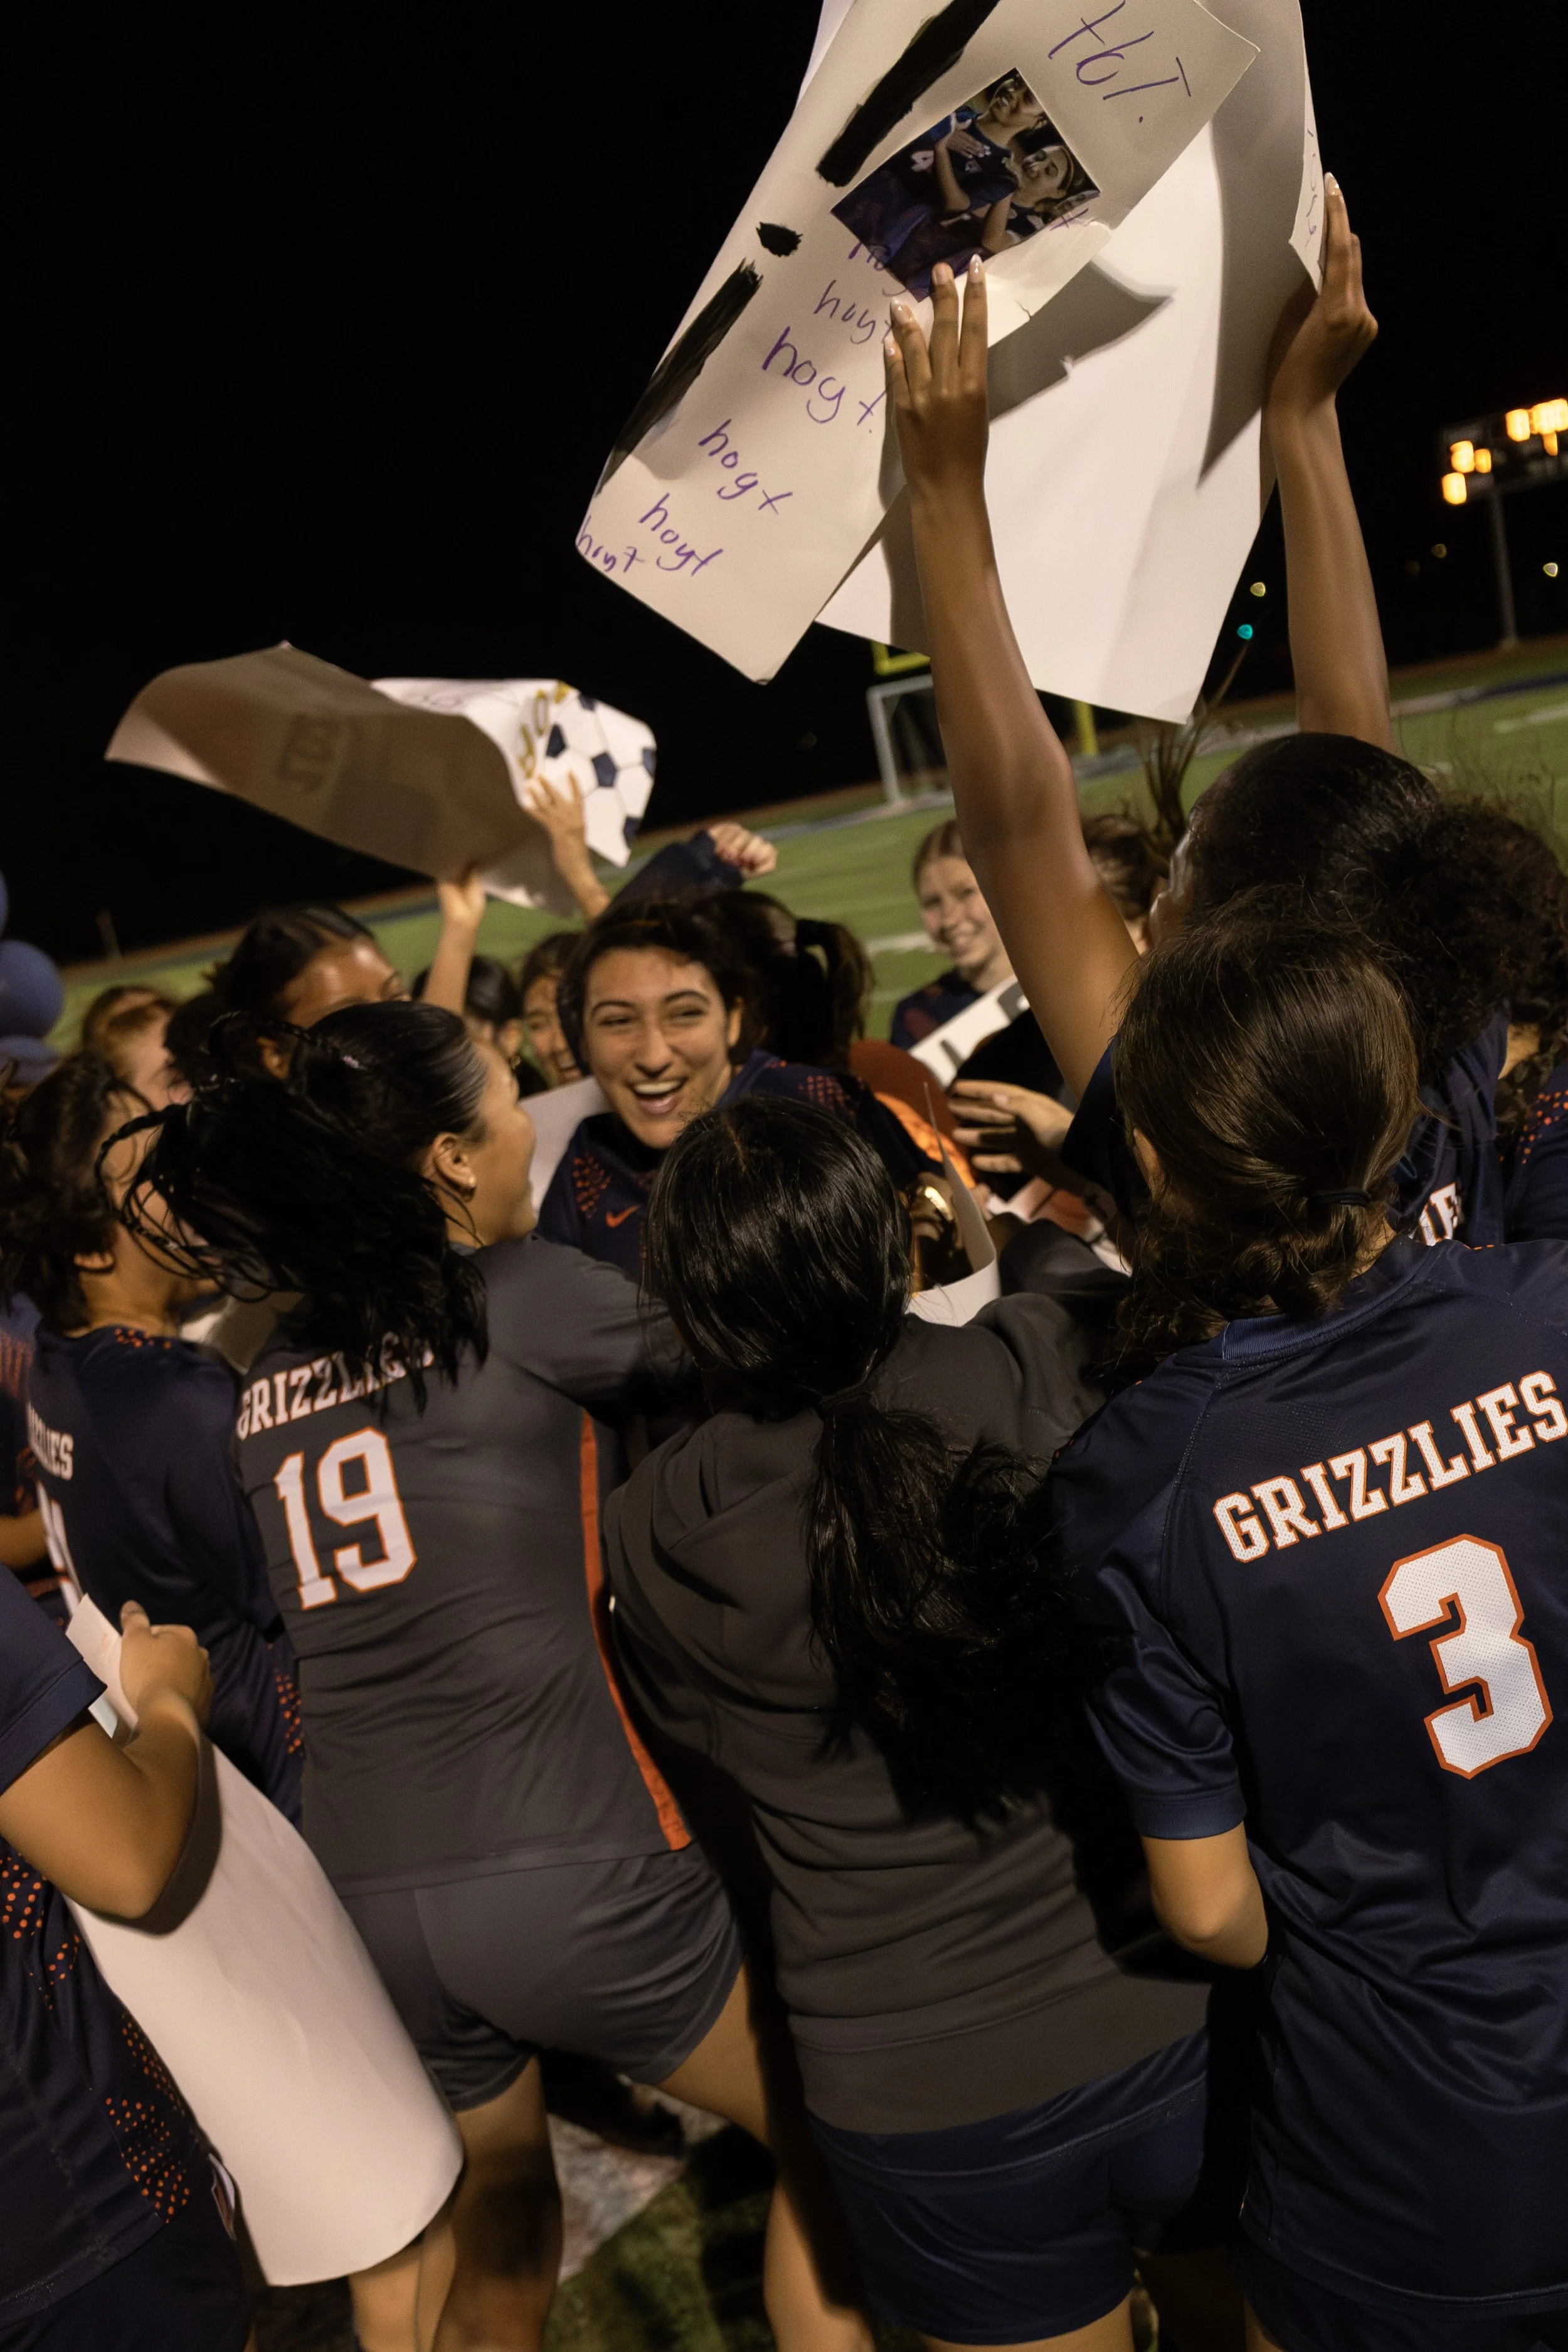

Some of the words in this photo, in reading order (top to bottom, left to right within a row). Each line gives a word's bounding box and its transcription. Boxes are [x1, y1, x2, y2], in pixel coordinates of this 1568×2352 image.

[273, 1426, 417, 1611] 19
[1213, 1370, 1568, 1562] GRIZZLIES
[1377, 1534, 1553, 1779] 3
